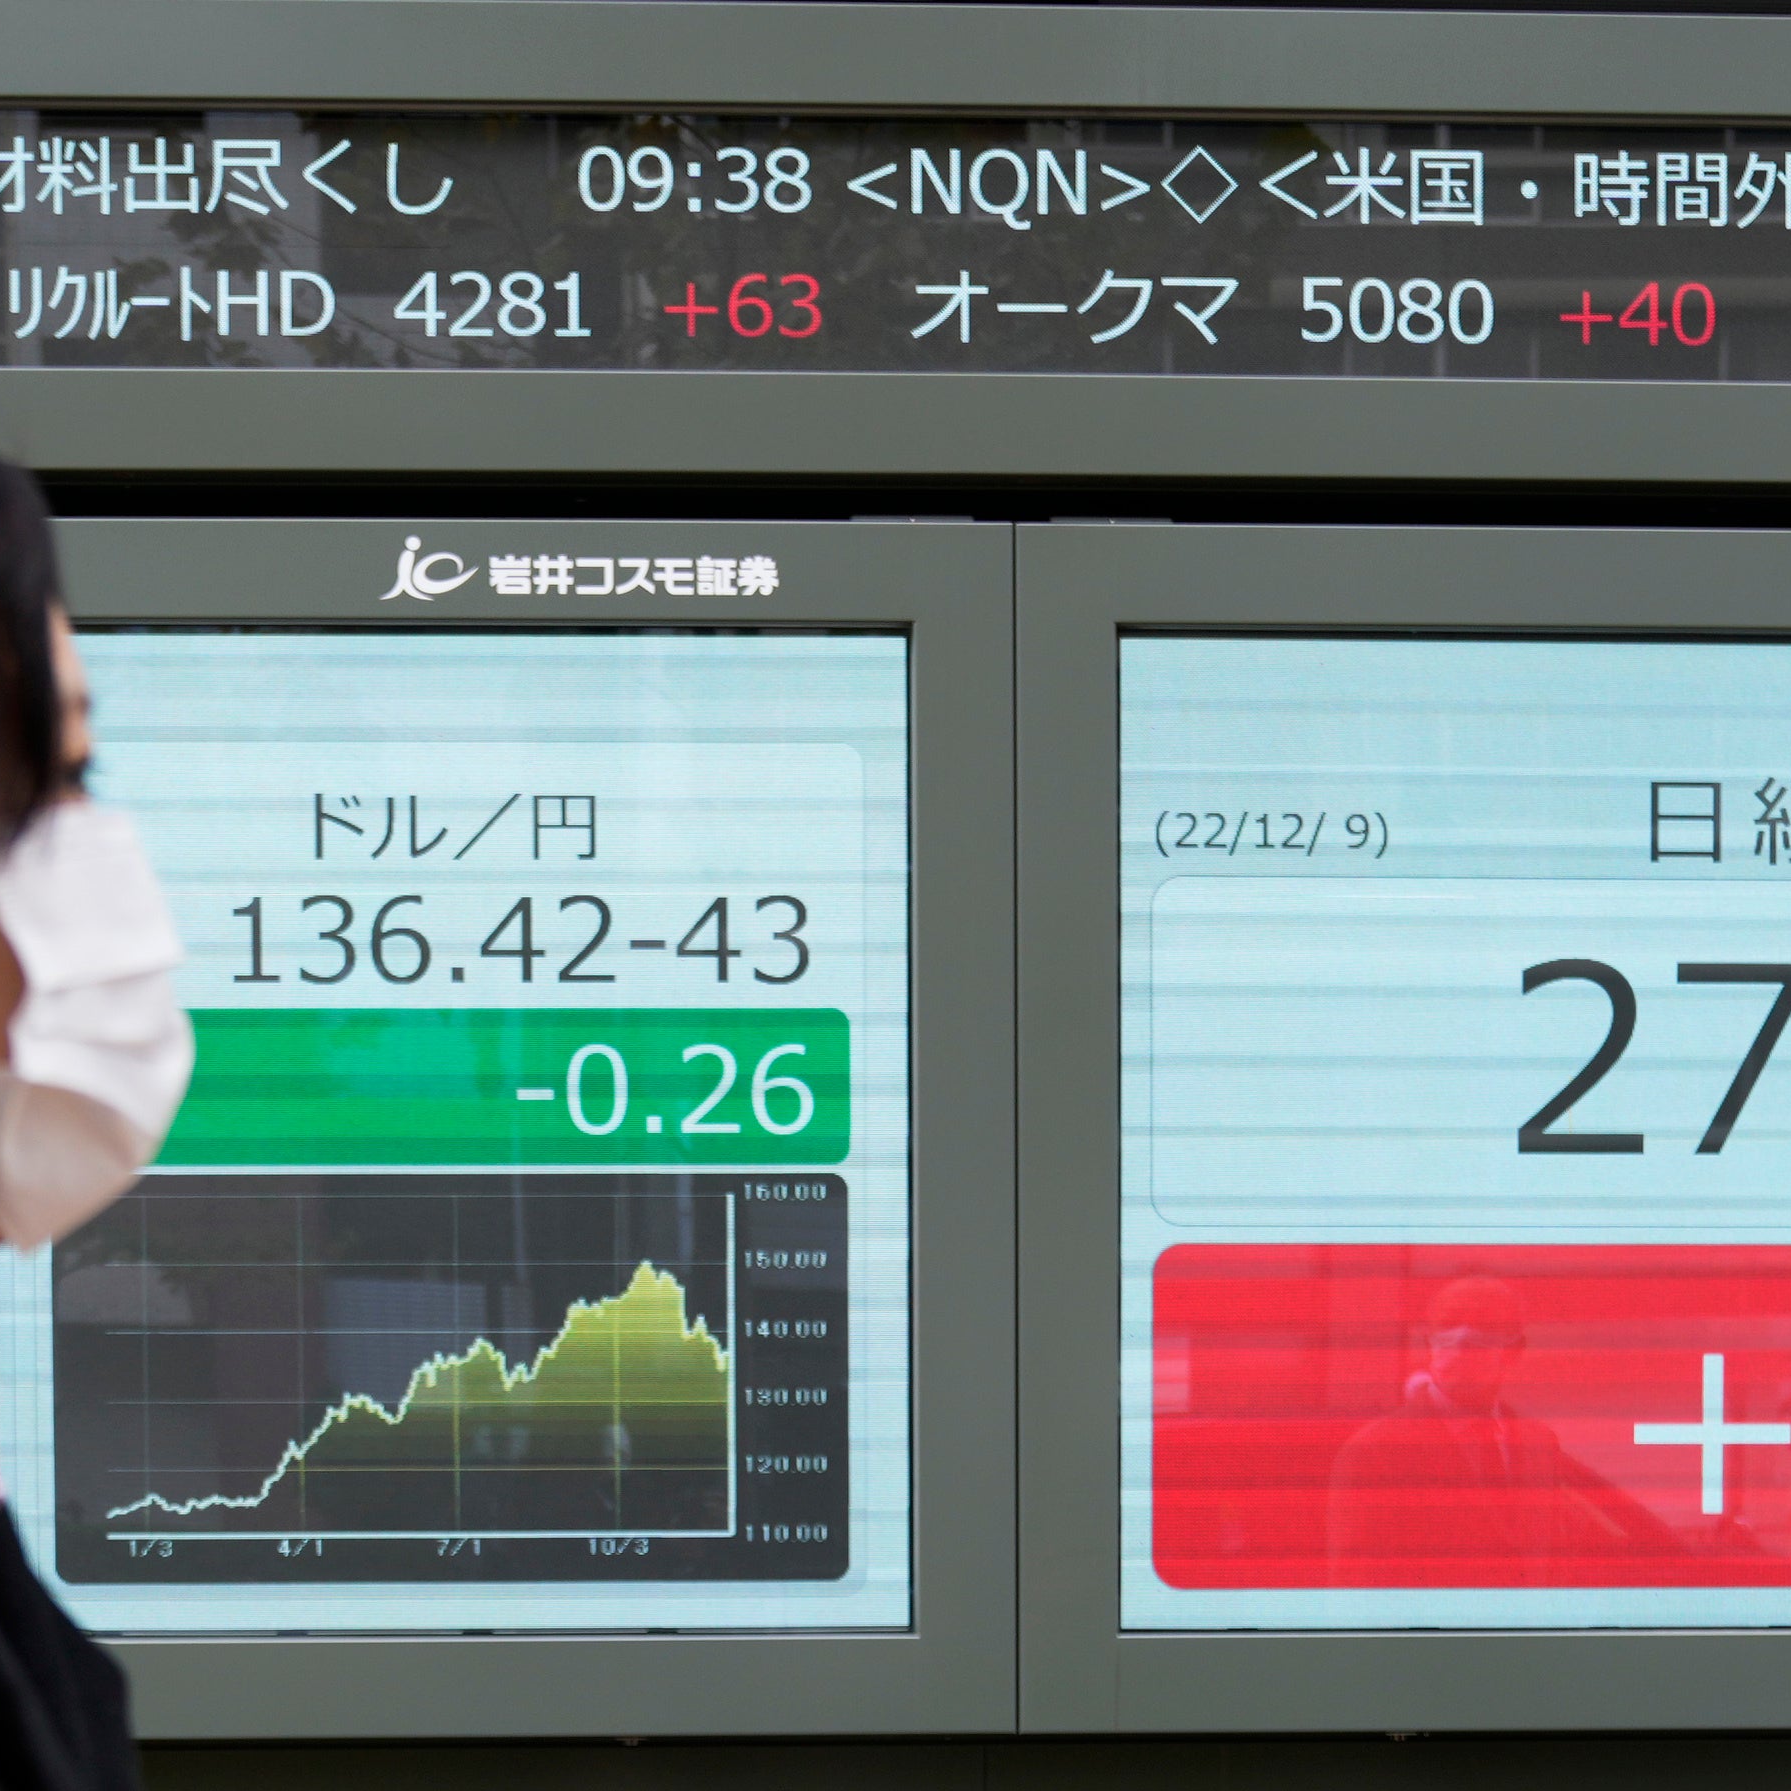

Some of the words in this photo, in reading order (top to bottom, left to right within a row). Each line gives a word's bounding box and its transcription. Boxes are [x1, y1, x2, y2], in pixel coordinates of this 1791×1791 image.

[579, 147, 811, 212] 09:38
[394, 272, 589, 336] 4281
[664, 273, 822, 338] +63
[911, 271, 1238, 344] オークマ
[1302, 278, 1493, 343] 5080
[1560, 282, 1716, 346] +40
[489, 554, 779, 595] 岩井コスモ証券
[312, 793, 597, 861] ドル/円
[233, 895, 809, 984] 136.42-43
[518, 1045, 812, 1134] -0.26
[744, 1183, 827, 1200] 160.00
[744, 1251, 827, 1269] 150.00
[744, 1319, 827, 1338] 140.00
[745, 1388, 828, 1406] 130.00
[745, 1455, 828, 1474] 120.00
[746, 1524, 828, 1543] 110.00
[128, 1538, 173, 1557] 1/3
[276, 1538, 322, 1557] 4/1
[436, 1538, 481, 1556] 7/1
[588, 1538, 650, 1555] 10/3
